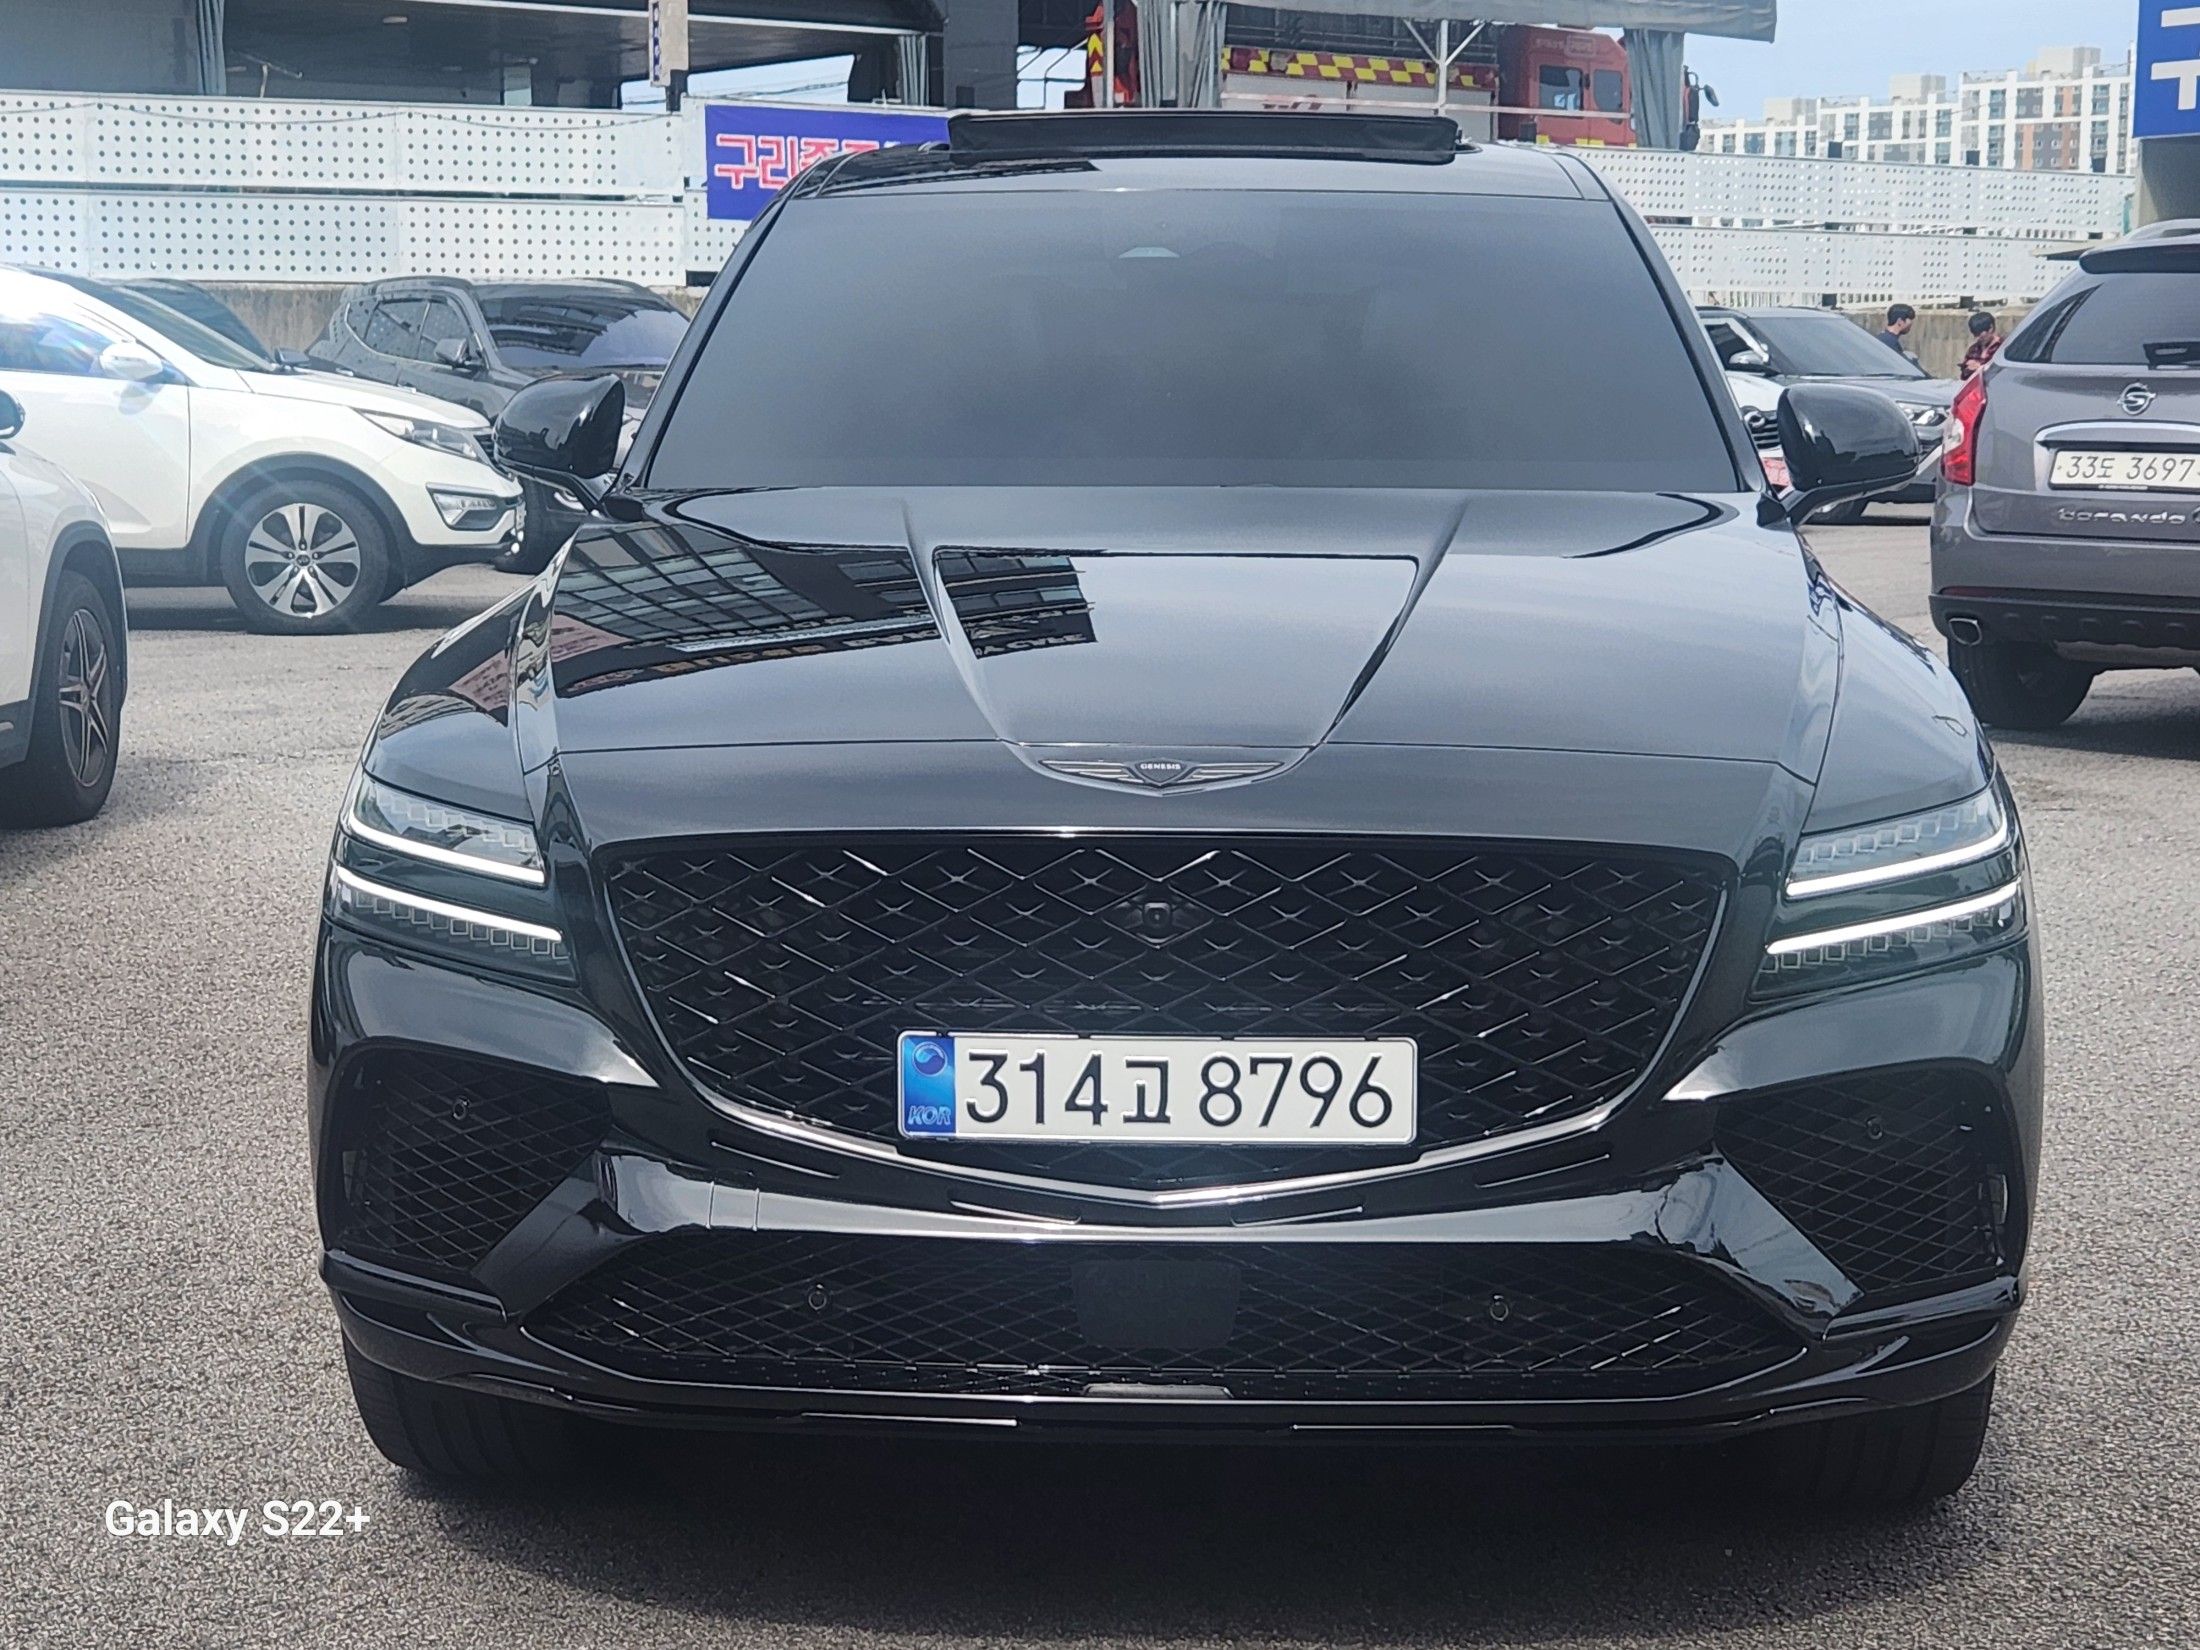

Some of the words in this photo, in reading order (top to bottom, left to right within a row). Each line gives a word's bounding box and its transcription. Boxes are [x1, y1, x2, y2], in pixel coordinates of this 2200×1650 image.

[2126, 457, 2195, 482] 3697
[966, 1051, 1171, 1127] 314고
[1199, 1054, 1393, 1129] 8796
[907, 1104, 952, 1126] KOR
